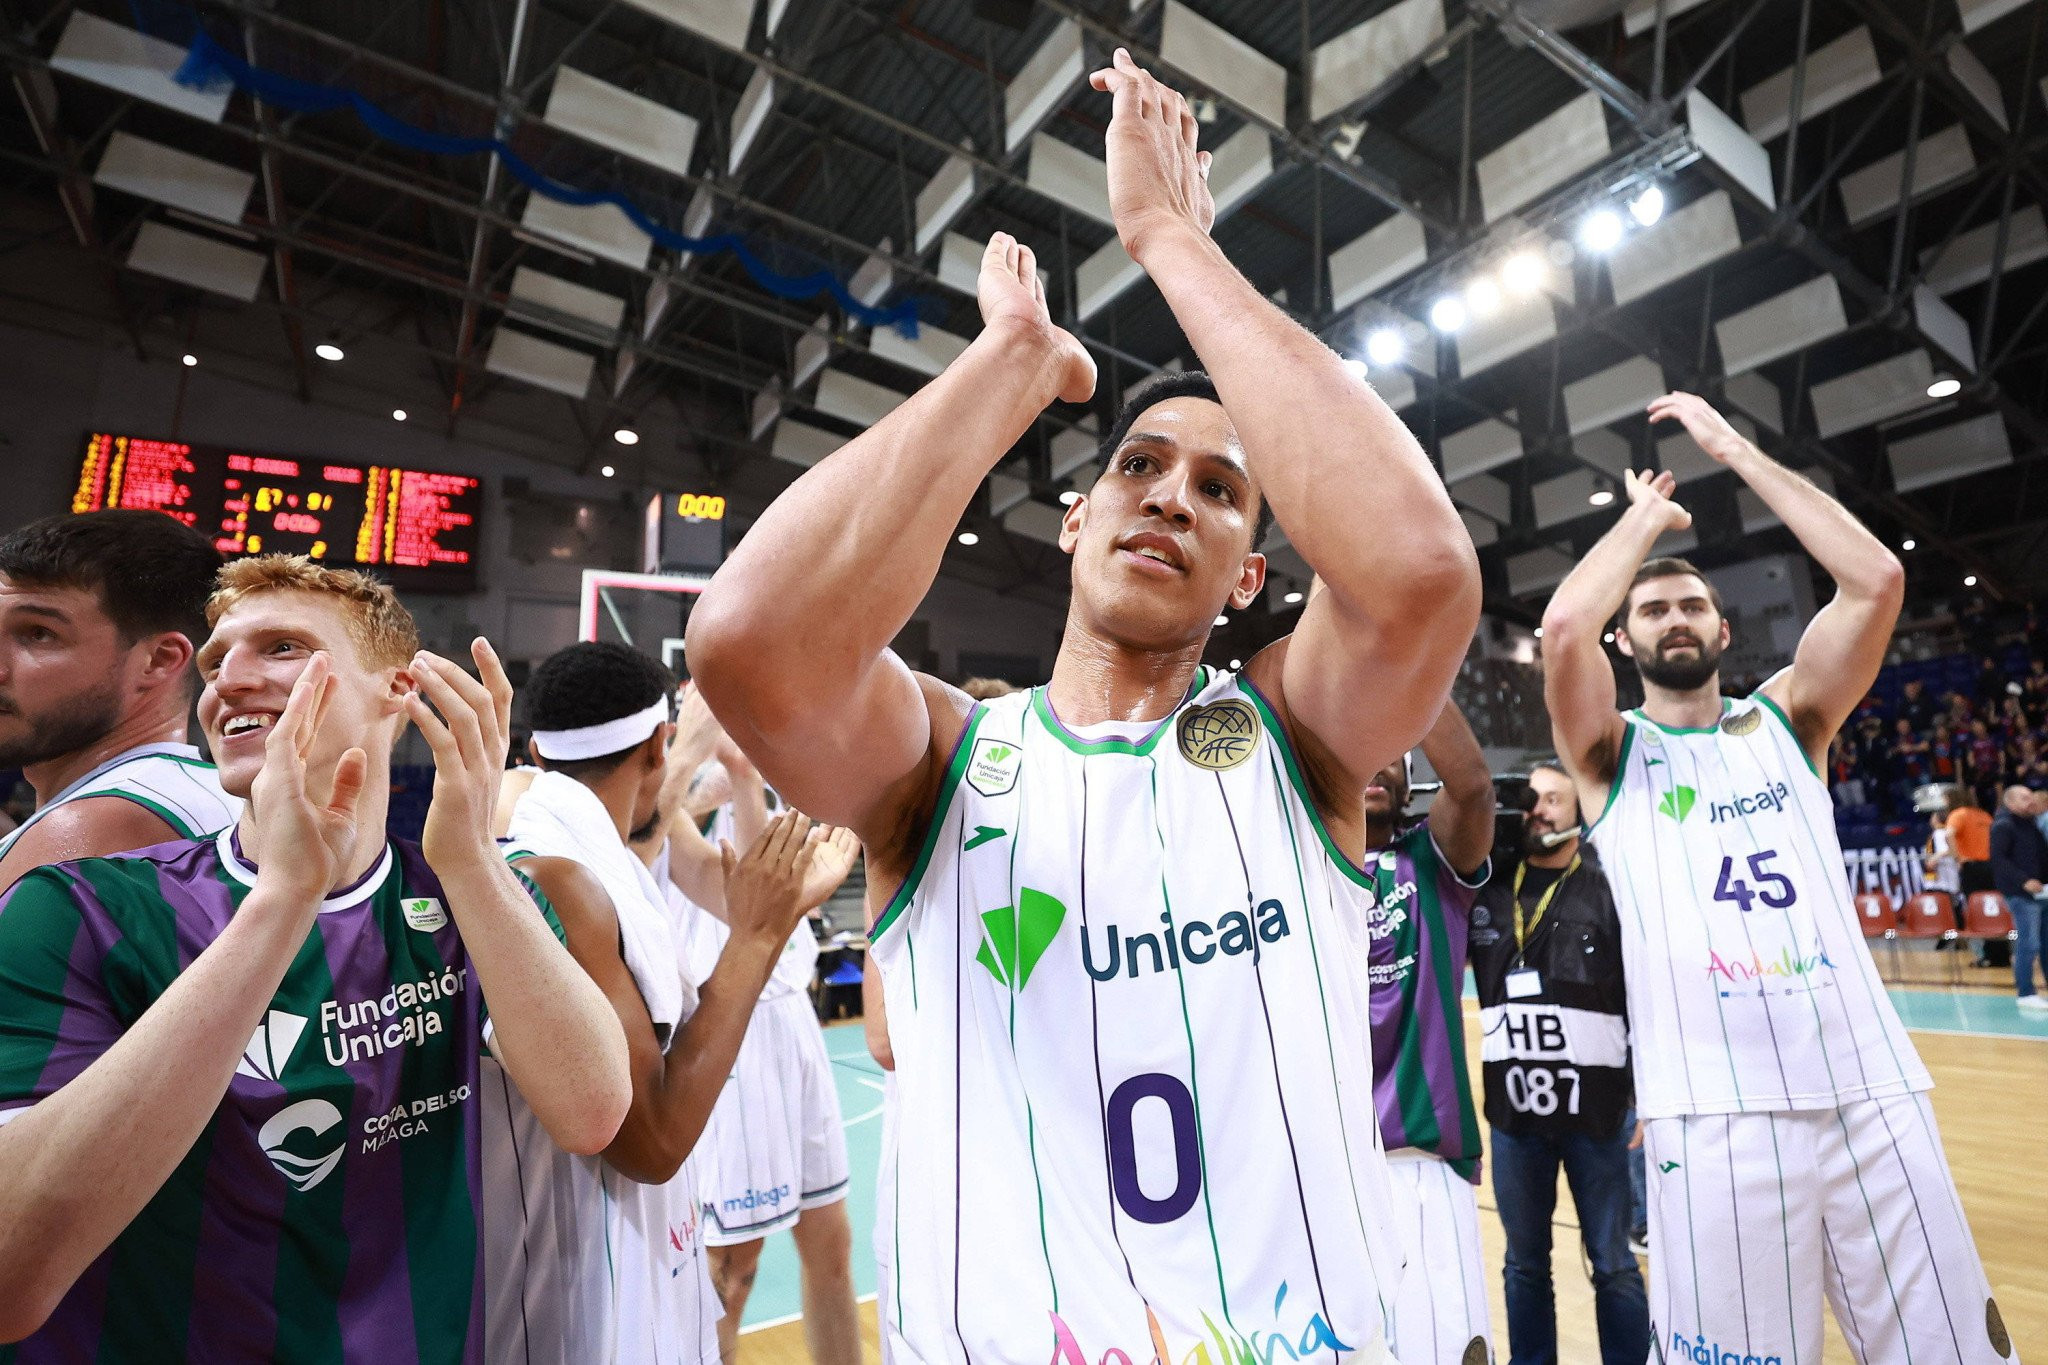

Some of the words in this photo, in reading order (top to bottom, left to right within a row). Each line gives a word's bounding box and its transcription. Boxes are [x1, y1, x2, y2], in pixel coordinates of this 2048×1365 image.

[976, 761, 1010, 776] Fundación
[979, 769, 1004, 783] Unicaja
[1713, 850, 1797, 912] 45
[1080, 891, 1290, 982] Unicaja
[324, 1006, 444, 1067] Unicaja
[1505, 1012, 1566, 1052] HB
[1505, 1064, 1580, 1116] 087
[362, 1119, 429, 1154] MÁAGA
[363, 1104, 409, 1134] COTA
[412, 1094, 448, 1117] DEL
[1107, 1072, 1202, 1224] 0
